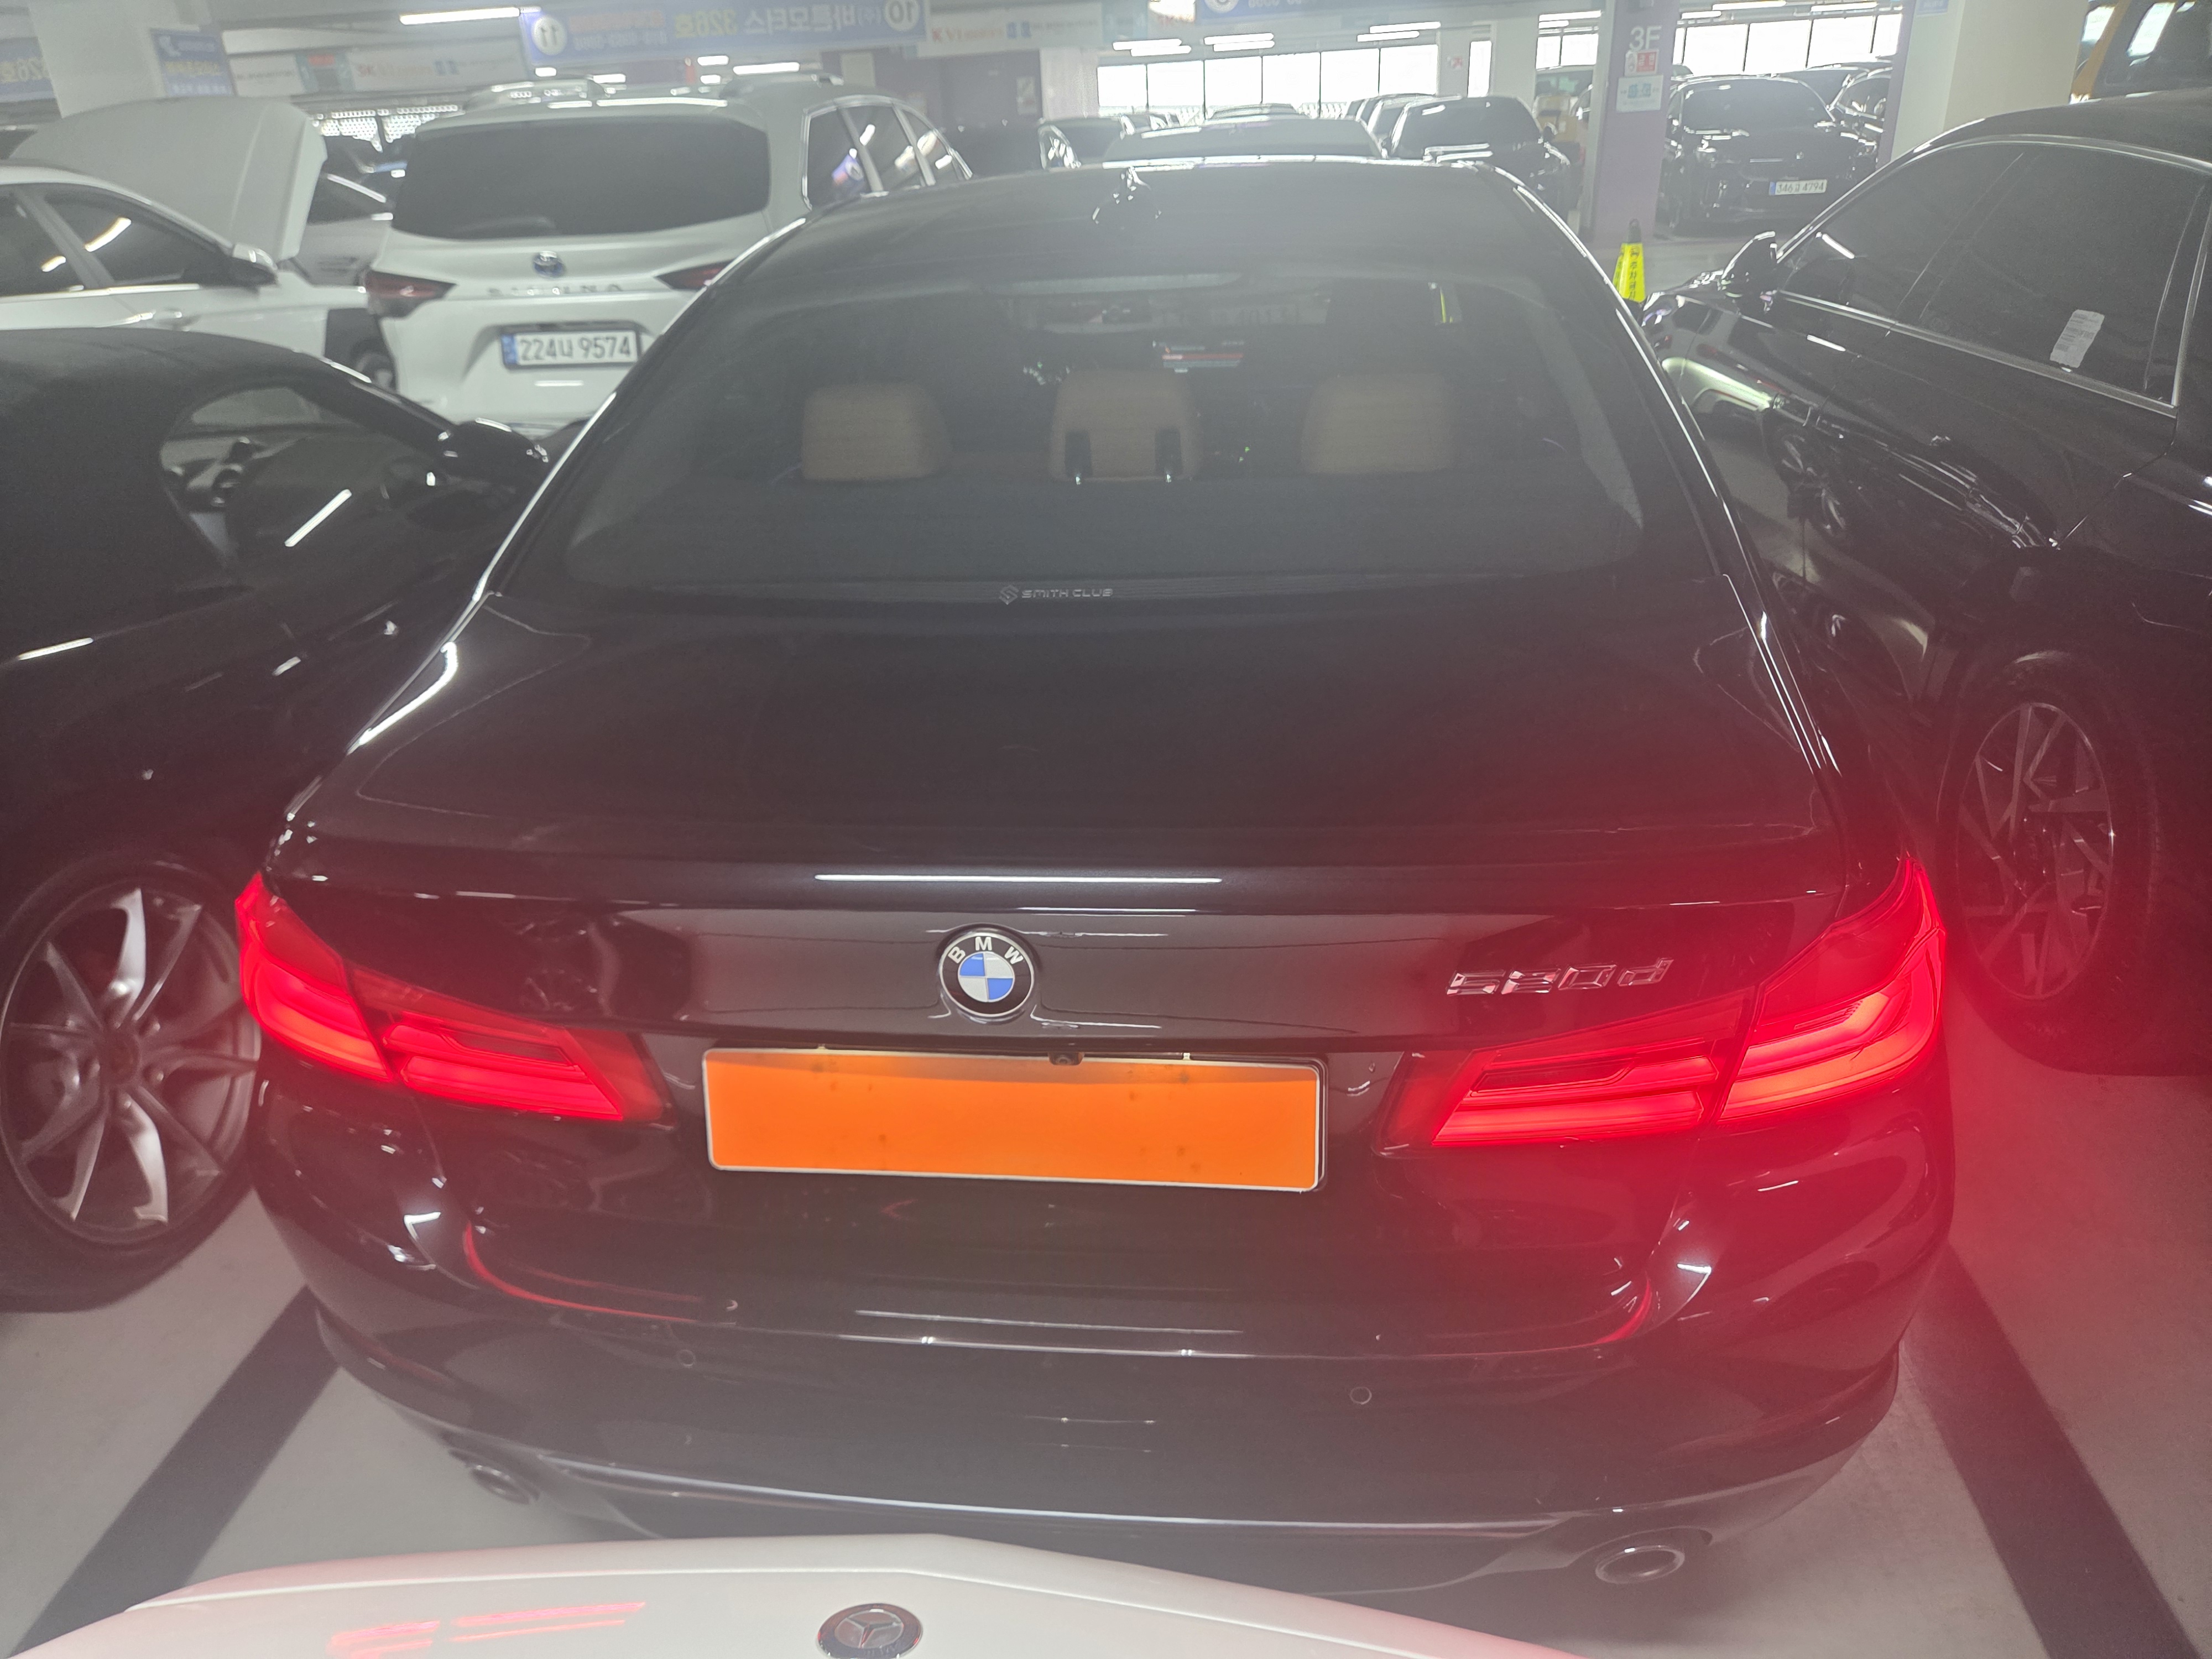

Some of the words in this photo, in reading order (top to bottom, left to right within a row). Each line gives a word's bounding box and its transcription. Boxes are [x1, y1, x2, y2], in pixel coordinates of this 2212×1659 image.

[1629, 25, 1662, 51] 3F
[577, 336, 630, 358] 9574
[1021, 588, 1069, 598] SMITH
[1072, 588, 1113, 597] CLUB
[947, 936, 1024, 965] BMW
[1446, 957, 1674, 996] 520d
